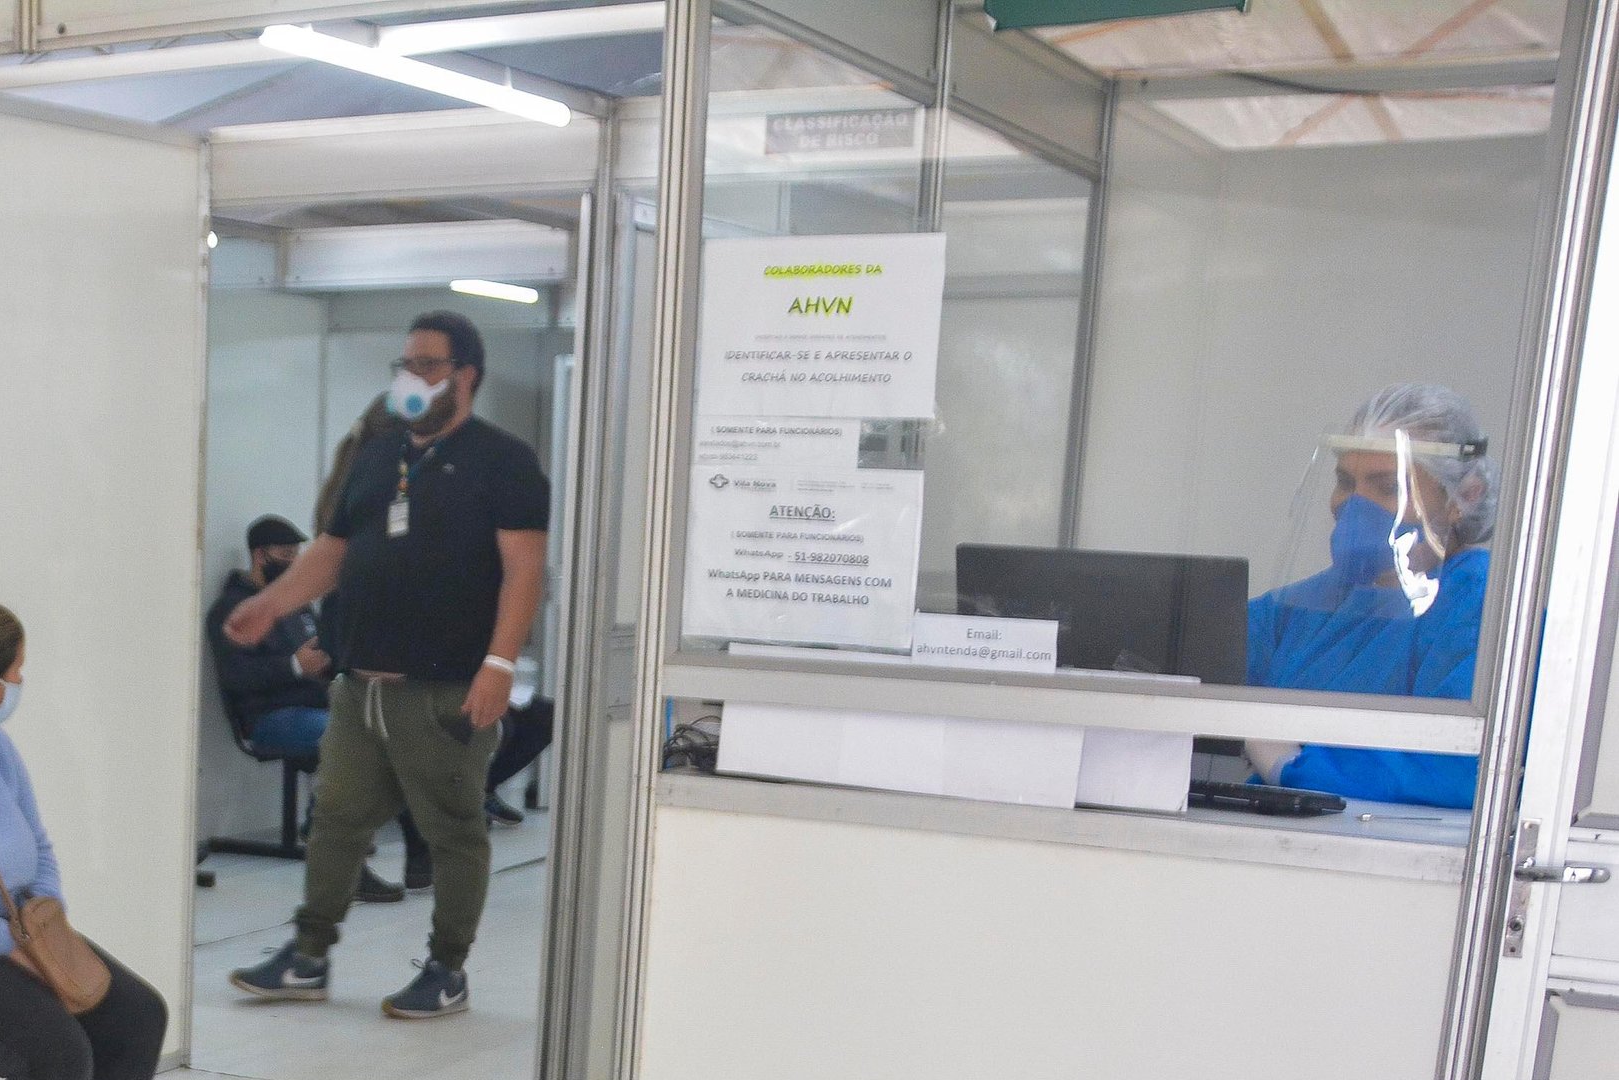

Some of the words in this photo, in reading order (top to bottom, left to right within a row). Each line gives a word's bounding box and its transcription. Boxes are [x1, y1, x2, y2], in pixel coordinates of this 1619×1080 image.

[799, 135, 820, 148] DE
[764, 264, 862, 276] COLABORADORES
[865, 264, 883, 274] DA
[787, 296, 853, 314] AHVN
[724, 350, 811, 361] IDENTIFICAR-SE
[813, 351, 821, 360] E
[824, 351, 900, 361] APRESENTAR
[903, 351, 912, 361] O
[741, 369, 786, 382] CRACHÁ
[789, 373, 806, 382] NO
[809, 372, 891, 383] ACOLHIMENTO
[756, 426, 778, 435] PARA
[769, 503, 836, 520] ATENÇÃO:
[776, 531, 798, 540] PARA
[734, 548, 784, 559] WhatsApp
[708, 568, 760, 581] WhatsApp
[763, 571, 791, 582] PARA
[794, 573, 861, 586] MENSAGENS
[864, 577, 892, 588] COM
[726, 588, 734, 598] A
[736, 588, 789, 601] MEDICINA
[792, 591, 808, 602] DO
[811, 592, 870, 605] TRABALHO
[966, 627, 1002, 640] Email:
[916, 643, 1052, 661] ahvntenda@gmail.com
